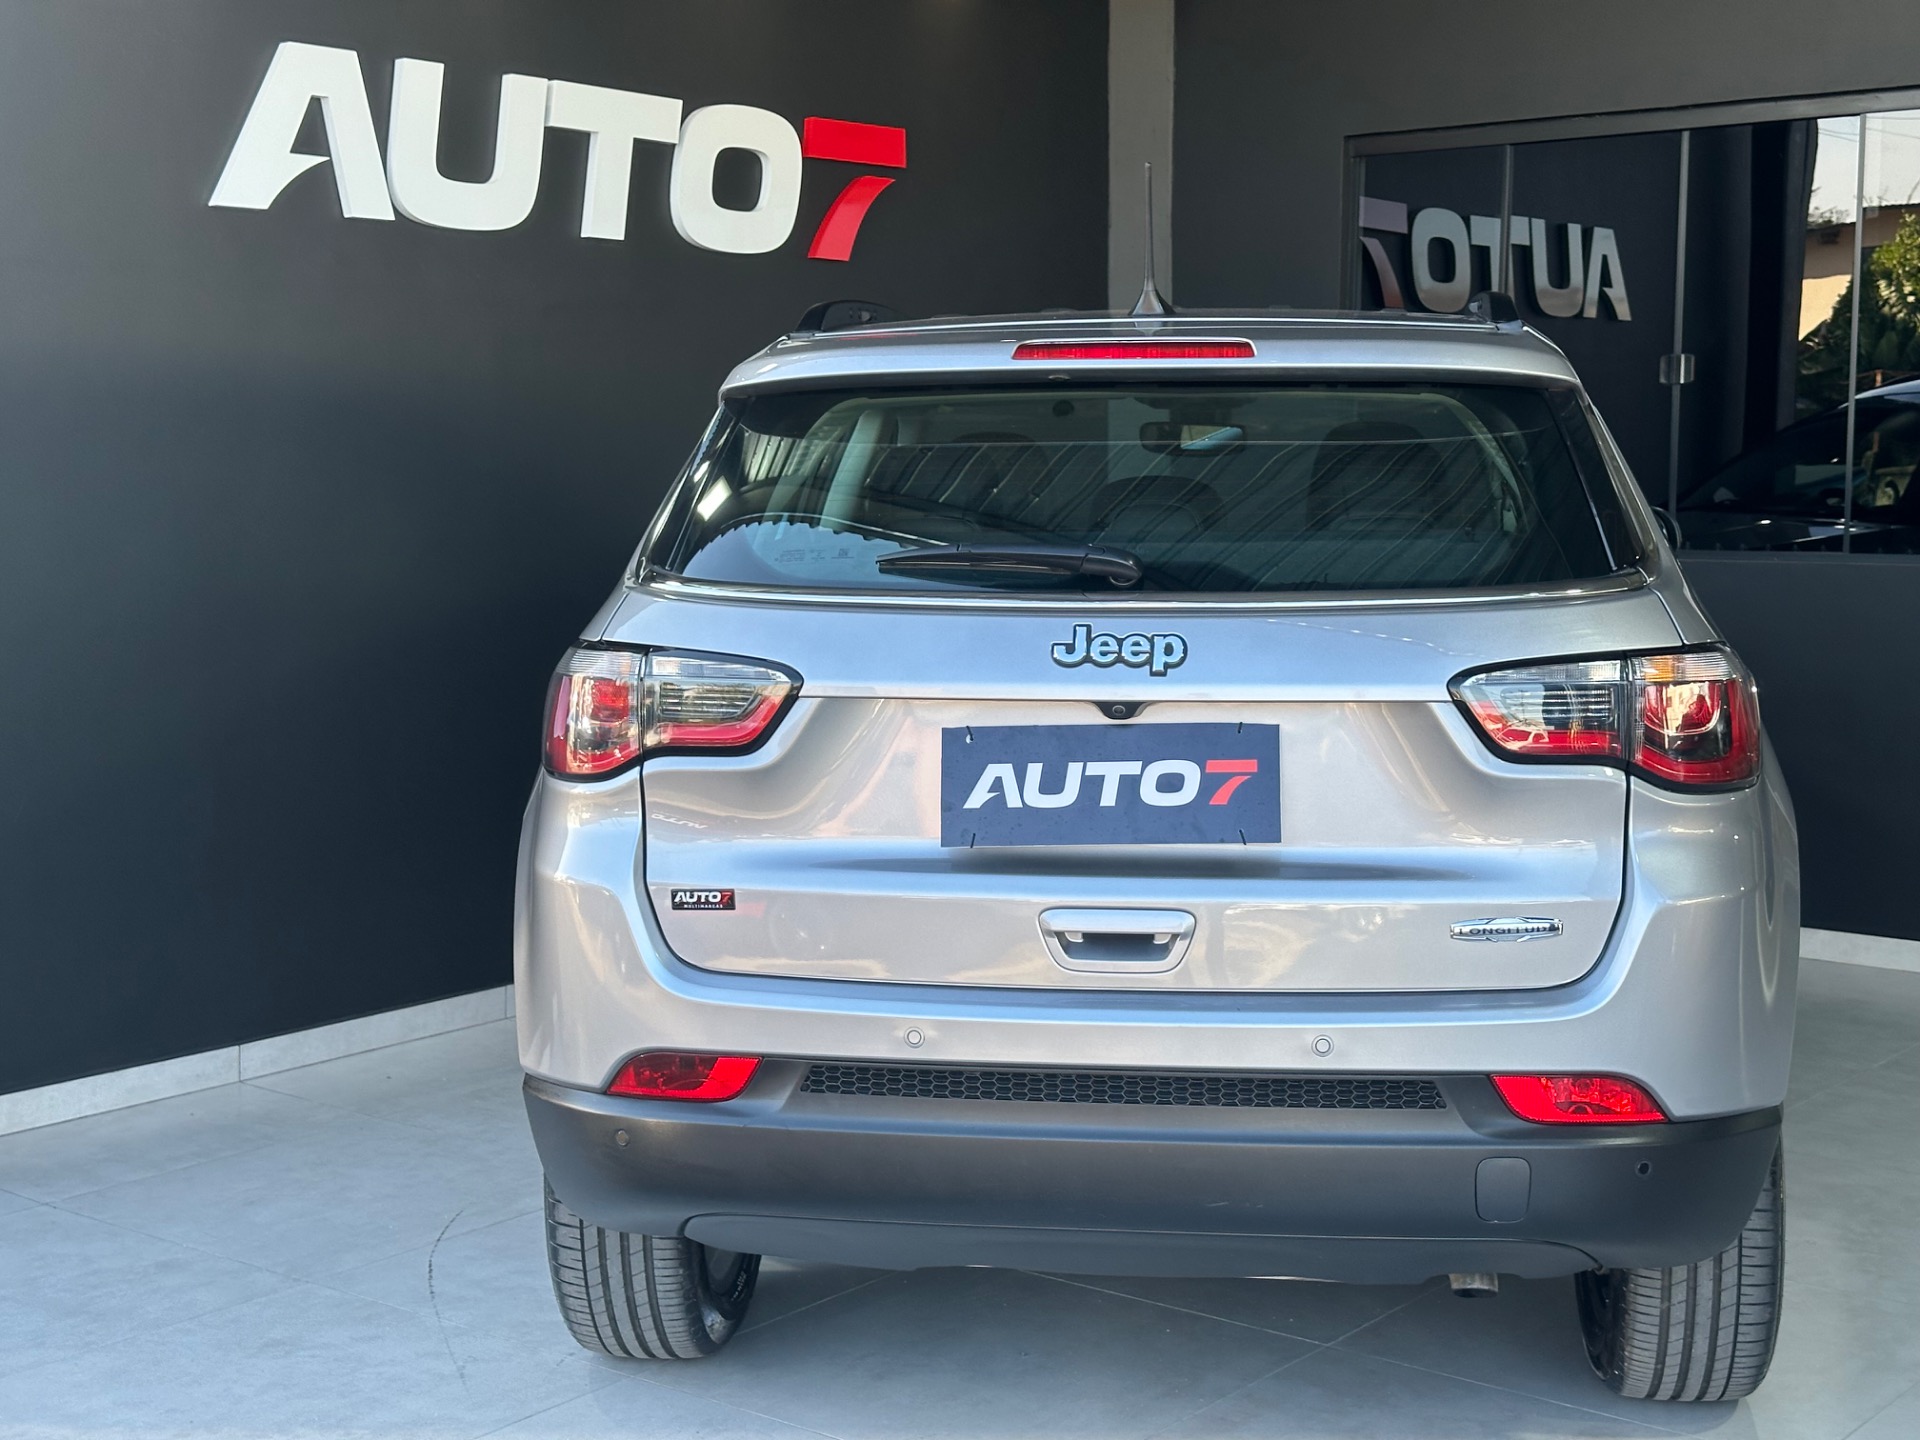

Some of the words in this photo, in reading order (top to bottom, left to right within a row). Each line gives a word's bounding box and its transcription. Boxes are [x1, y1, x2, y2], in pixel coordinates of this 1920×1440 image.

[208, 41, 906, 262] AUTO7
[1052, 623, 1188, 677] Jeep
[963, 759, 1258, 809] AUTO7
[673, 891, 732, 903] AUTO7
